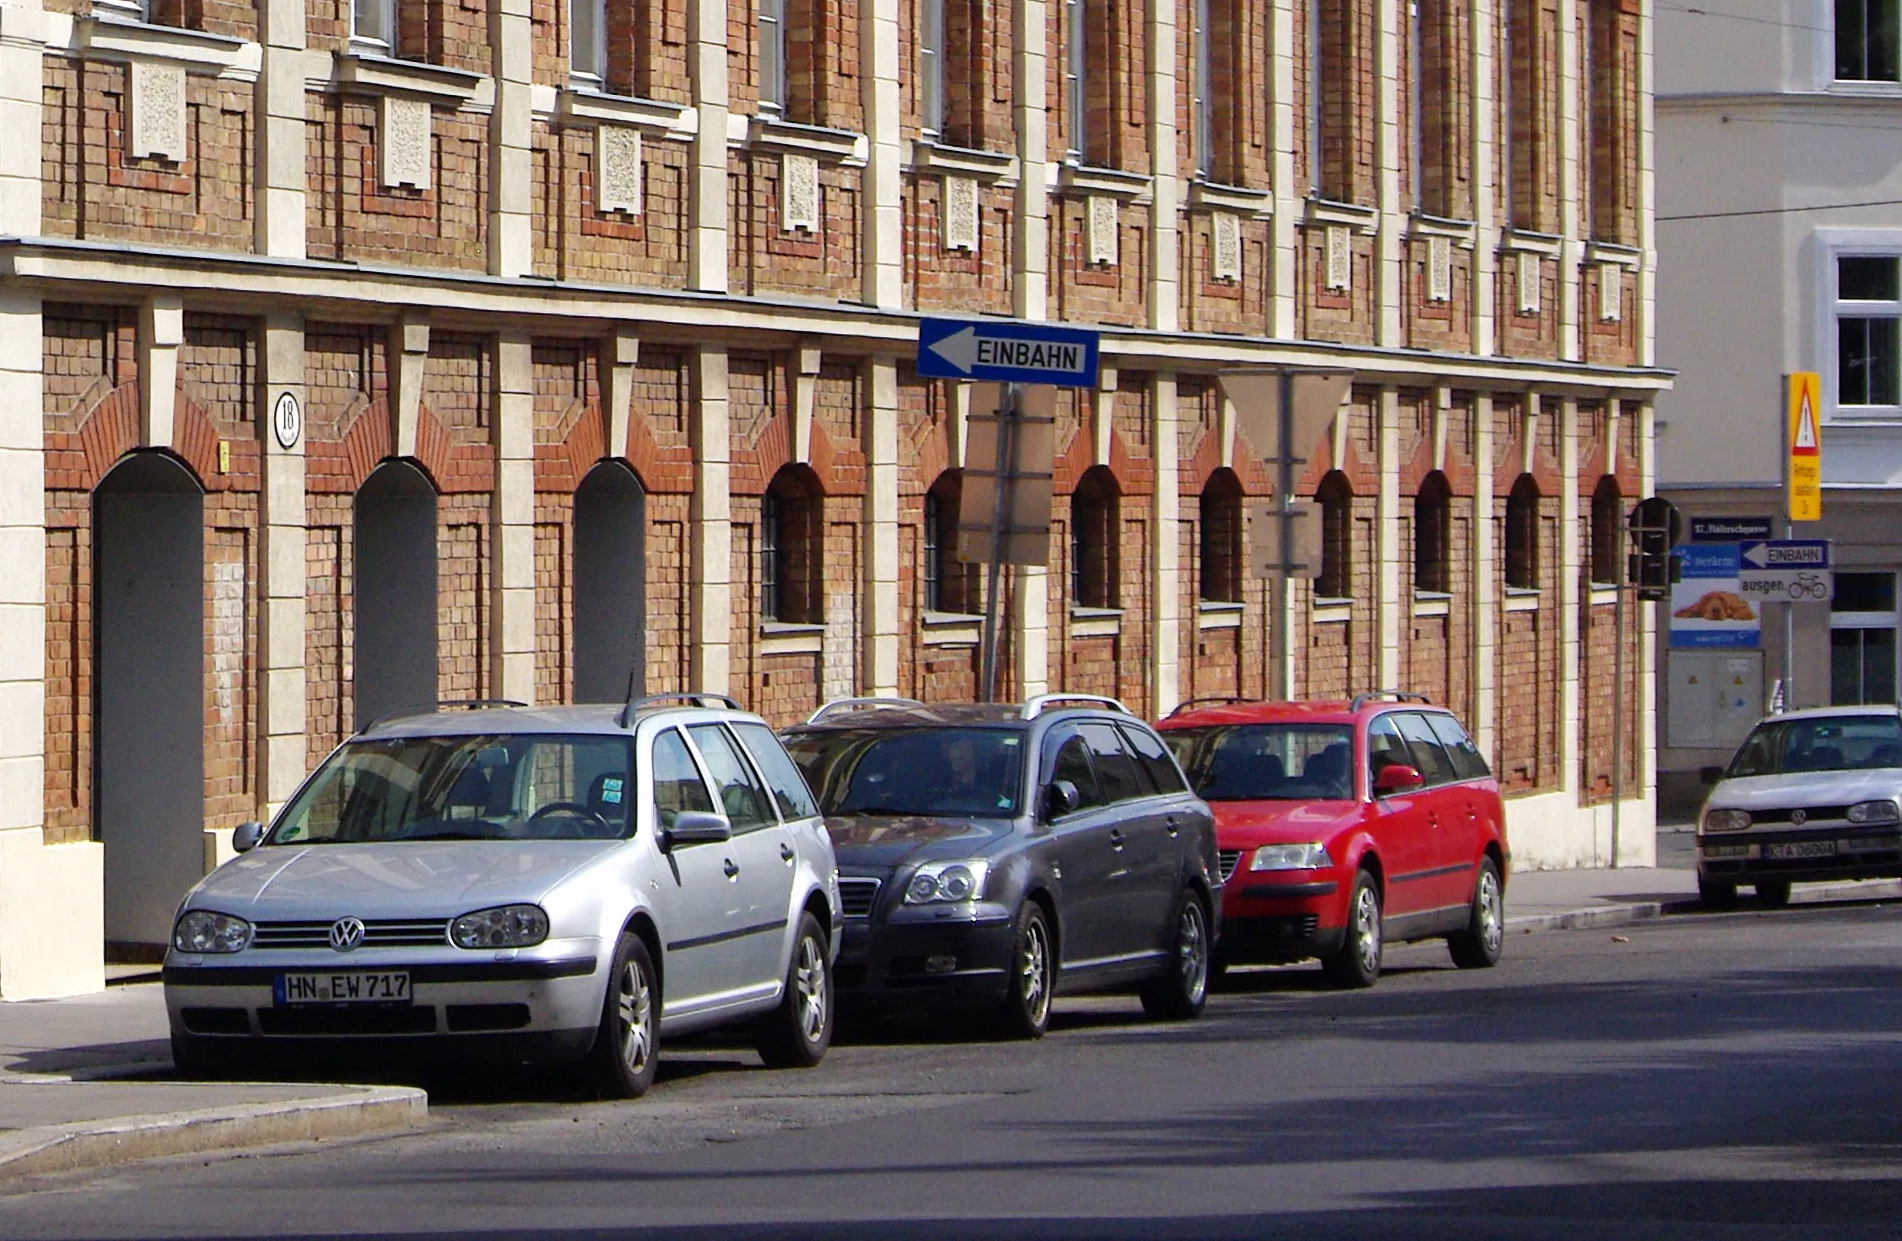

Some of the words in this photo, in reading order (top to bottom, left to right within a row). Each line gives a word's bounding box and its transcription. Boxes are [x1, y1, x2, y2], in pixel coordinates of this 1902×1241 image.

[977, 340, 1078, 369] EINBAHN
[283, 400, 294, 430] 18
[1768, 548, 1819, 562] EINBAHN
[1742, 579, 1787, 595] ausgen.
[288, 976, 317, 999] HN
[331, 976, 359, 998] EW
[365, 974, 408, 997] 717
